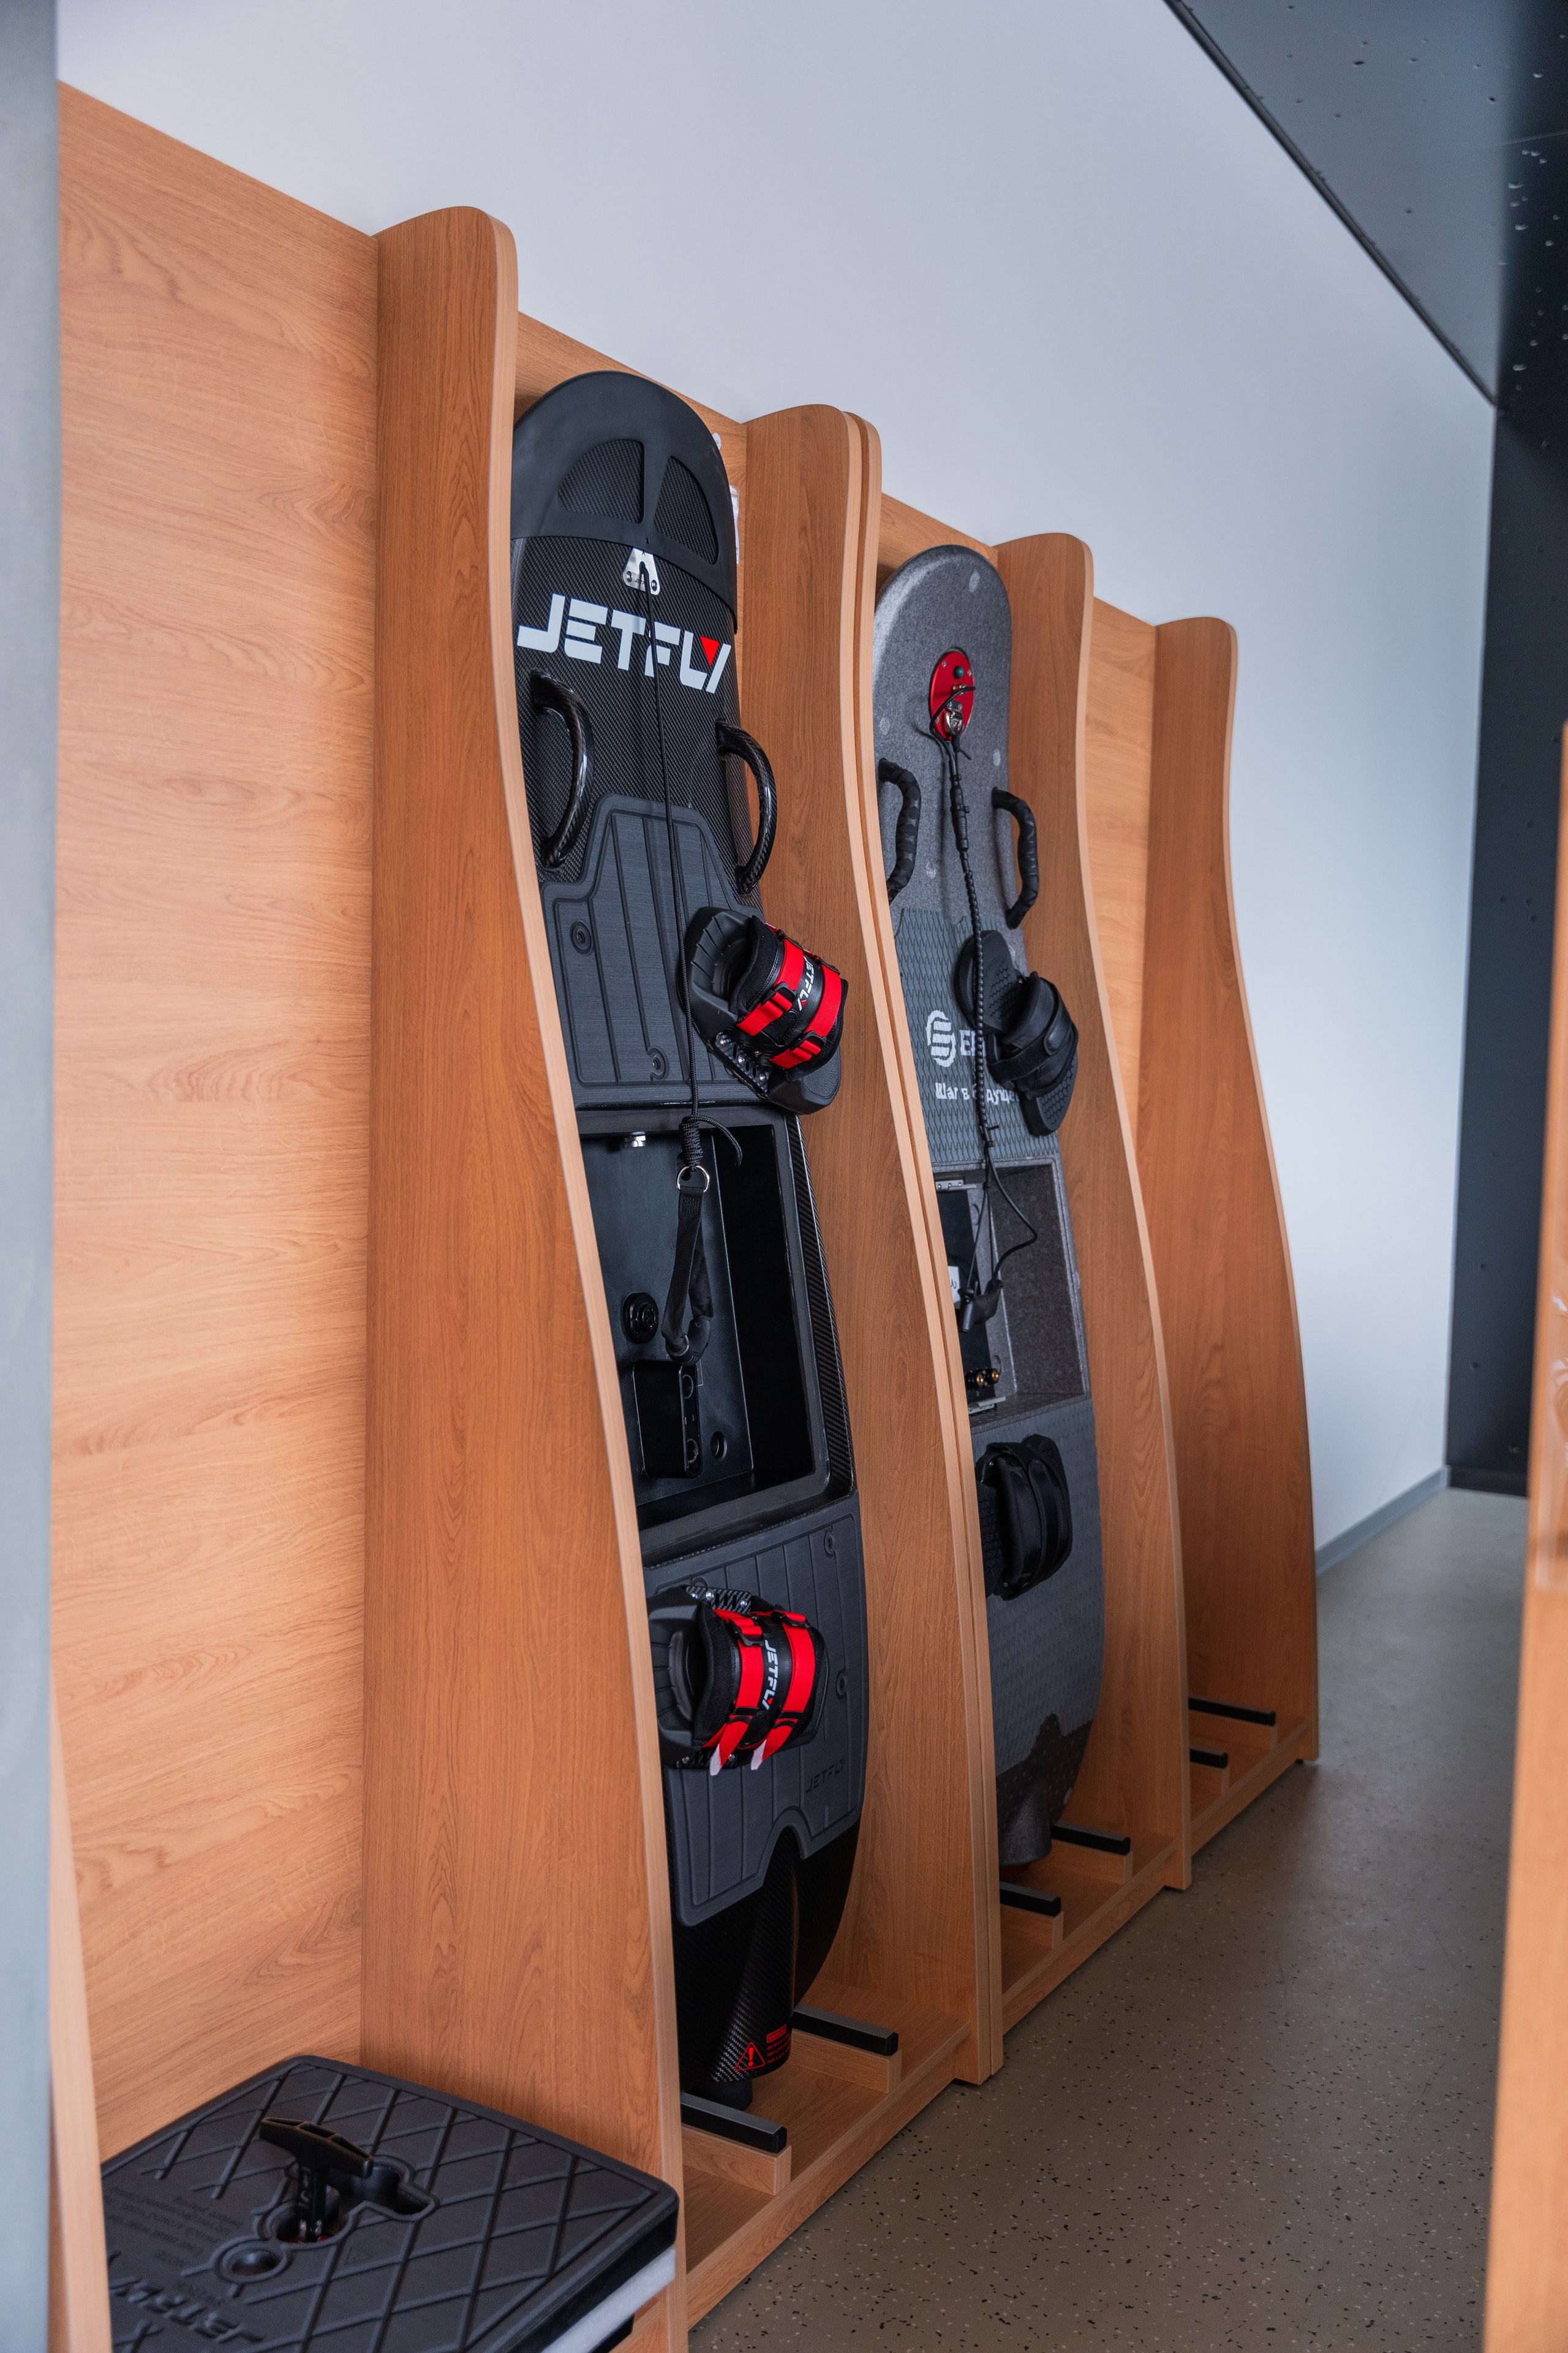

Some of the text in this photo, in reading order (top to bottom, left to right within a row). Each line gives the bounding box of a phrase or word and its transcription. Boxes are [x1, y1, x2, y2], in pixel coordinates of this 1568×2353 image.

[517, 593, 731, 693] JETFLY
[797, 956, 815, 1011] JETFLY
[935, 1082, 958, 1100] Шаг
[961, 1087, 970, 1100] в
[762, 1639, 778, 1710] JETFLY
[805, 1758, 845, 1794] JETFLY
